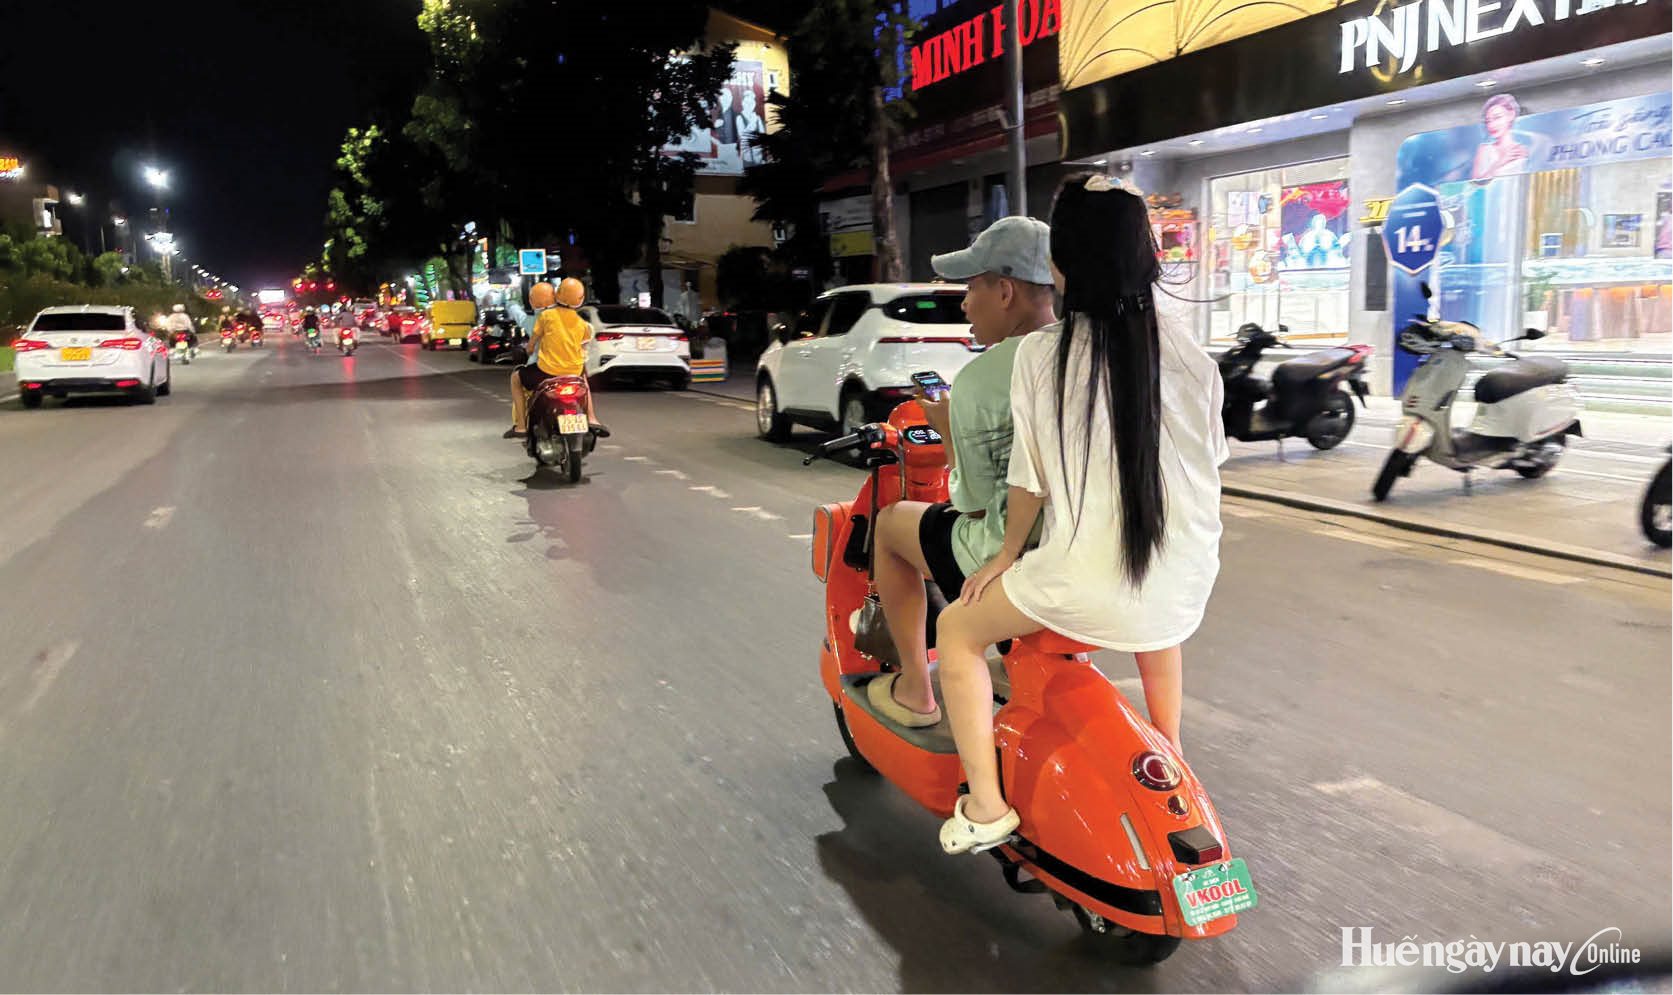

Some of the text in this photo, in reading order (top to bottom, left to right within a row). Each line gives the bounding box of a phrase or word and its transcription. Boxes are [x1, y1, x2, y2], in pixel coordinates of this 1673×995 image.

[911, 13, 984, 92] MINH
[1339, 0, 1421, 74] PNJ
[1547, 135, 1628, 162] PHONG
[1185, 879, 1248, 908] VKOOL
